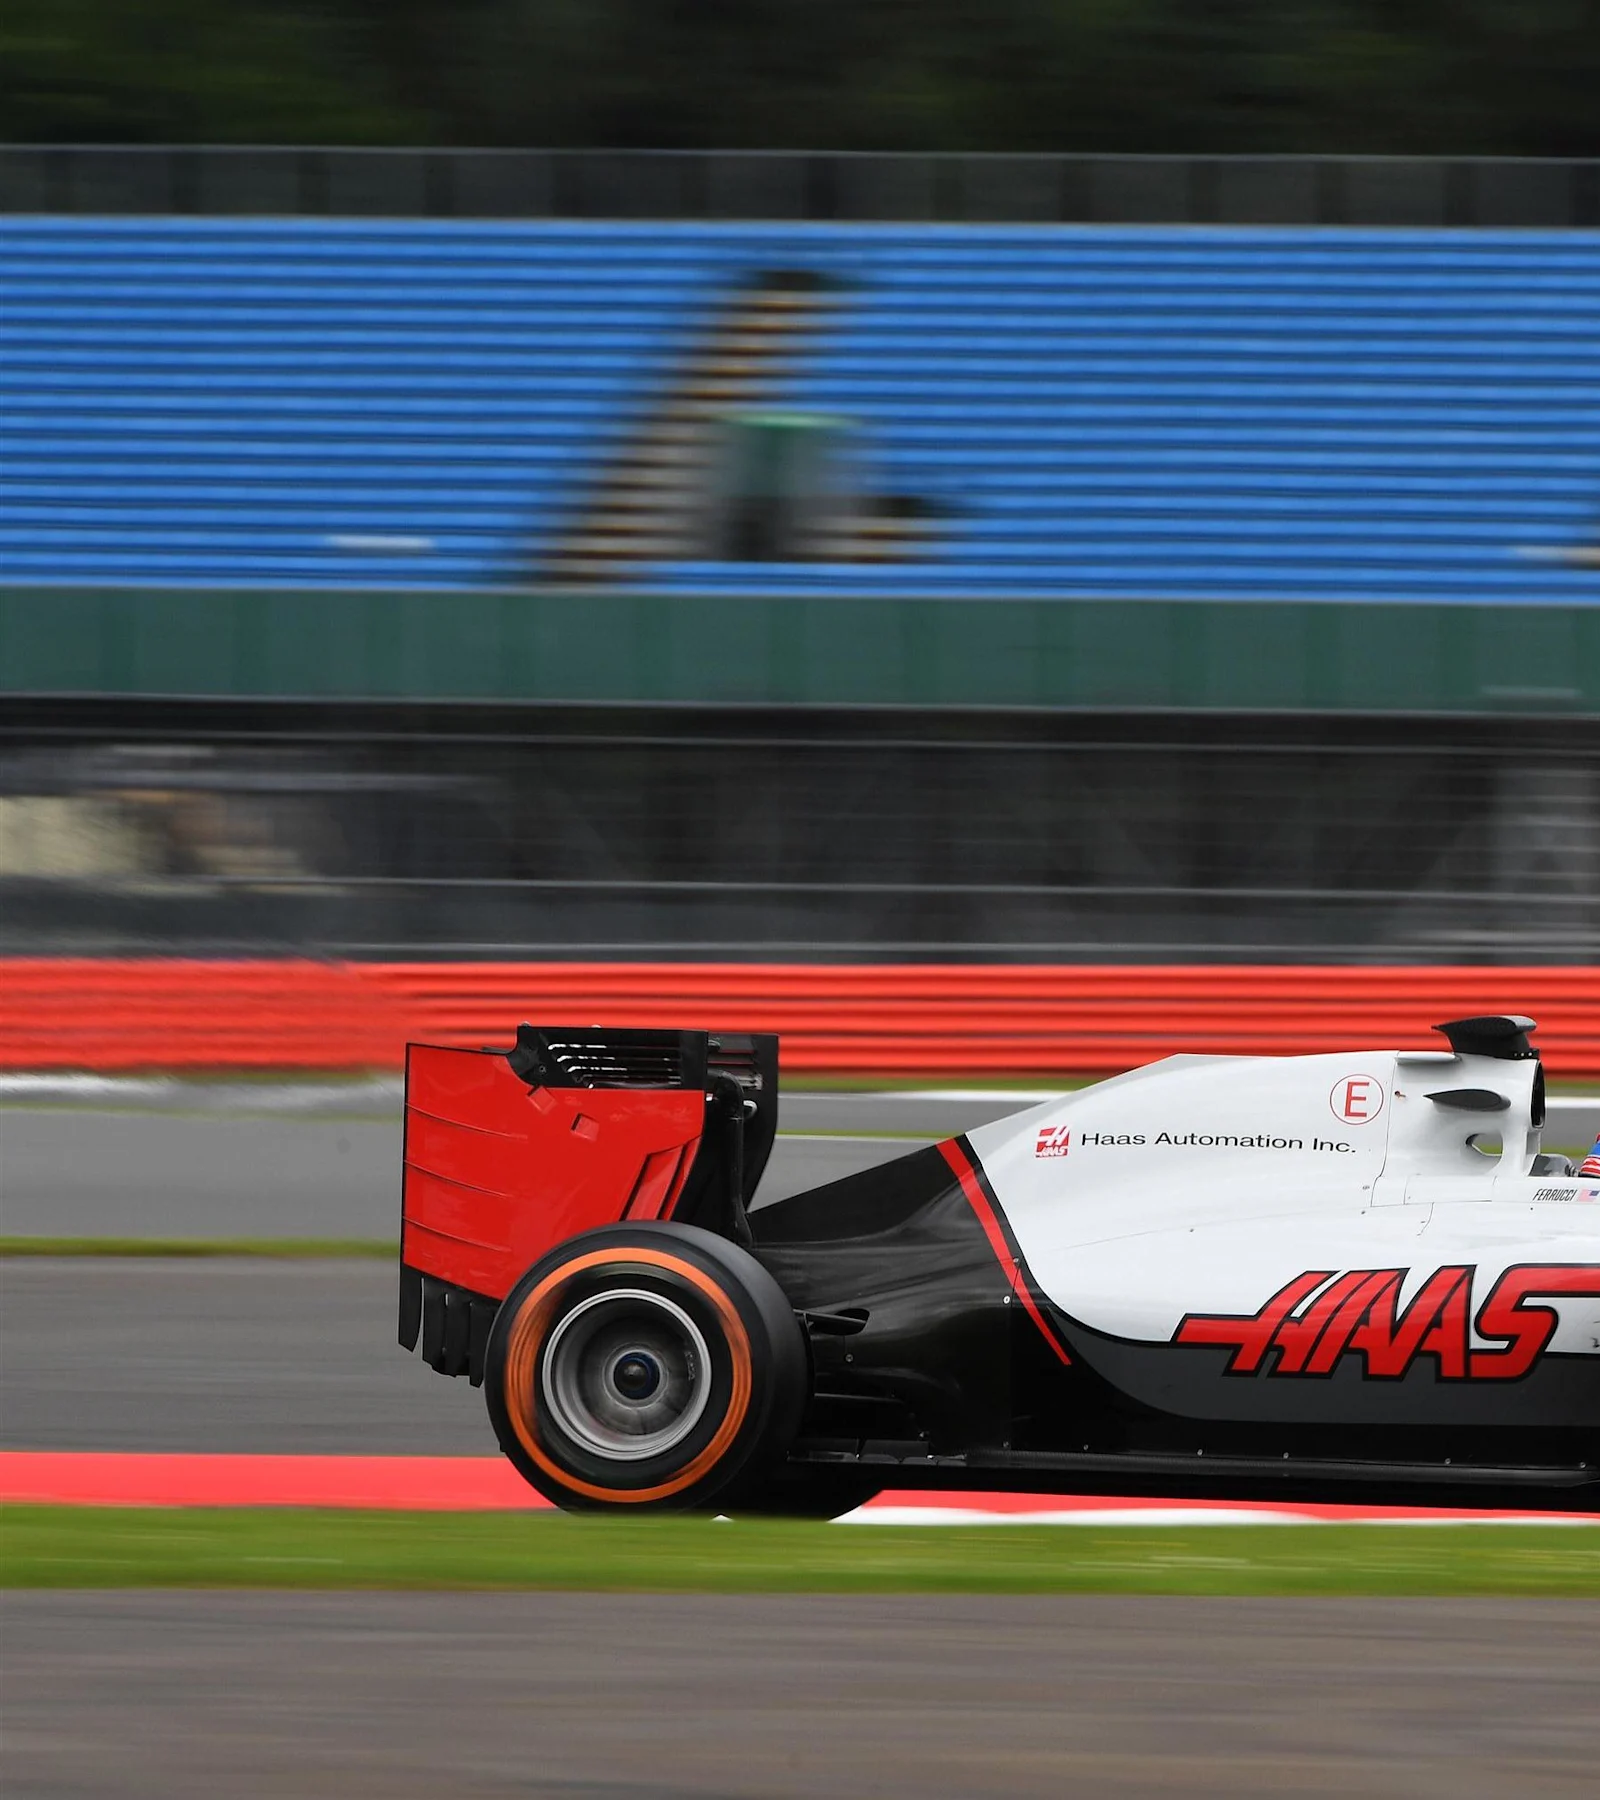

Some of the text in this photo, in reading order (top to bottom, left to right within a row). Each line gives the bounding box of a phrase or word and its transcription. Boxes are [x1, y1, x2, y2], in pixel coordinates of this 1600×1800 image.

[1344, 1081, 1370, 1118] E
[1081, 1131, 1357, 1154] Haas Automation Inc.
[1531, 1188, 1578, 1202] FERRUCCI
